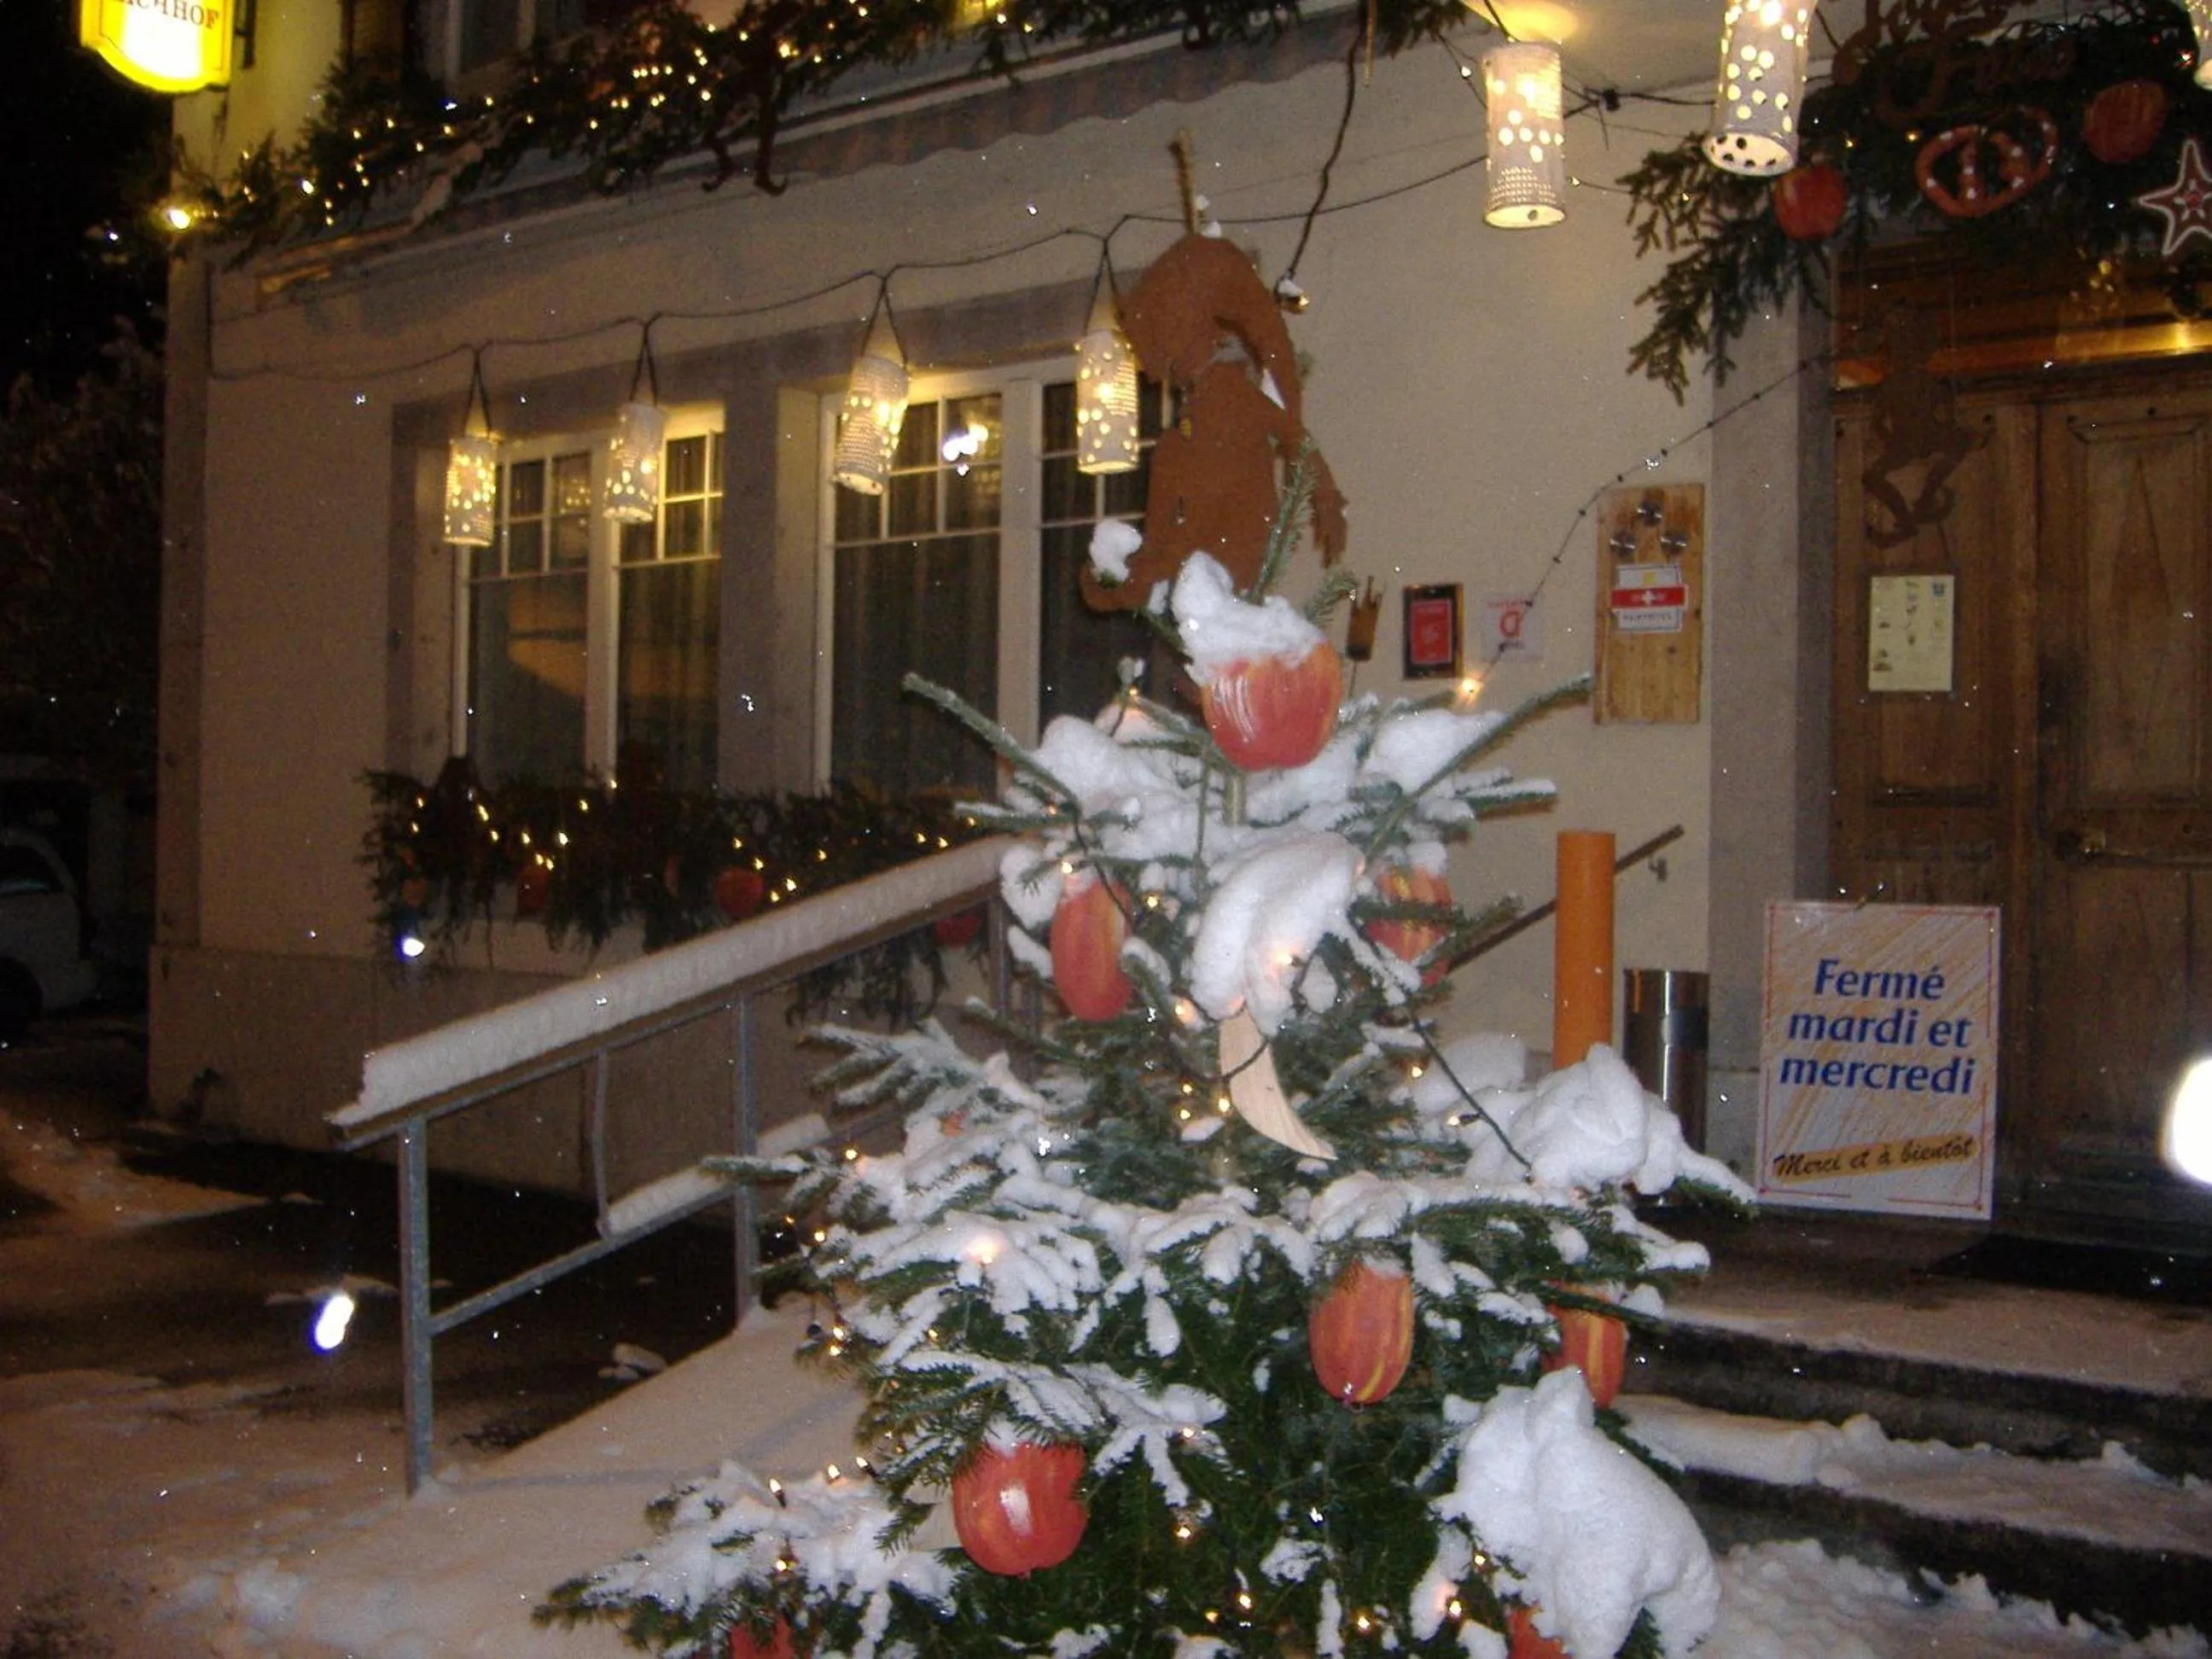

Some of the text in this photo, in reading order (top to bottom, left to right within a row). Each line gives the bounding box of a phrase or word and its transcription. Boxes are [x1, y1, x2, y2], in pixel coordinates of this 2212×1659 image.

[1814, 958, 1945, 1000] Fermé
[1789, 1008, 1972, 1048] mardi et
[1780, 1057, 1976, 1094] mercredi
[1773, 1153, 1841, 1177] Merci
[1850, 1150, 1869, 1170] et
[1901, 1136, 1973, 1164] bientôt
